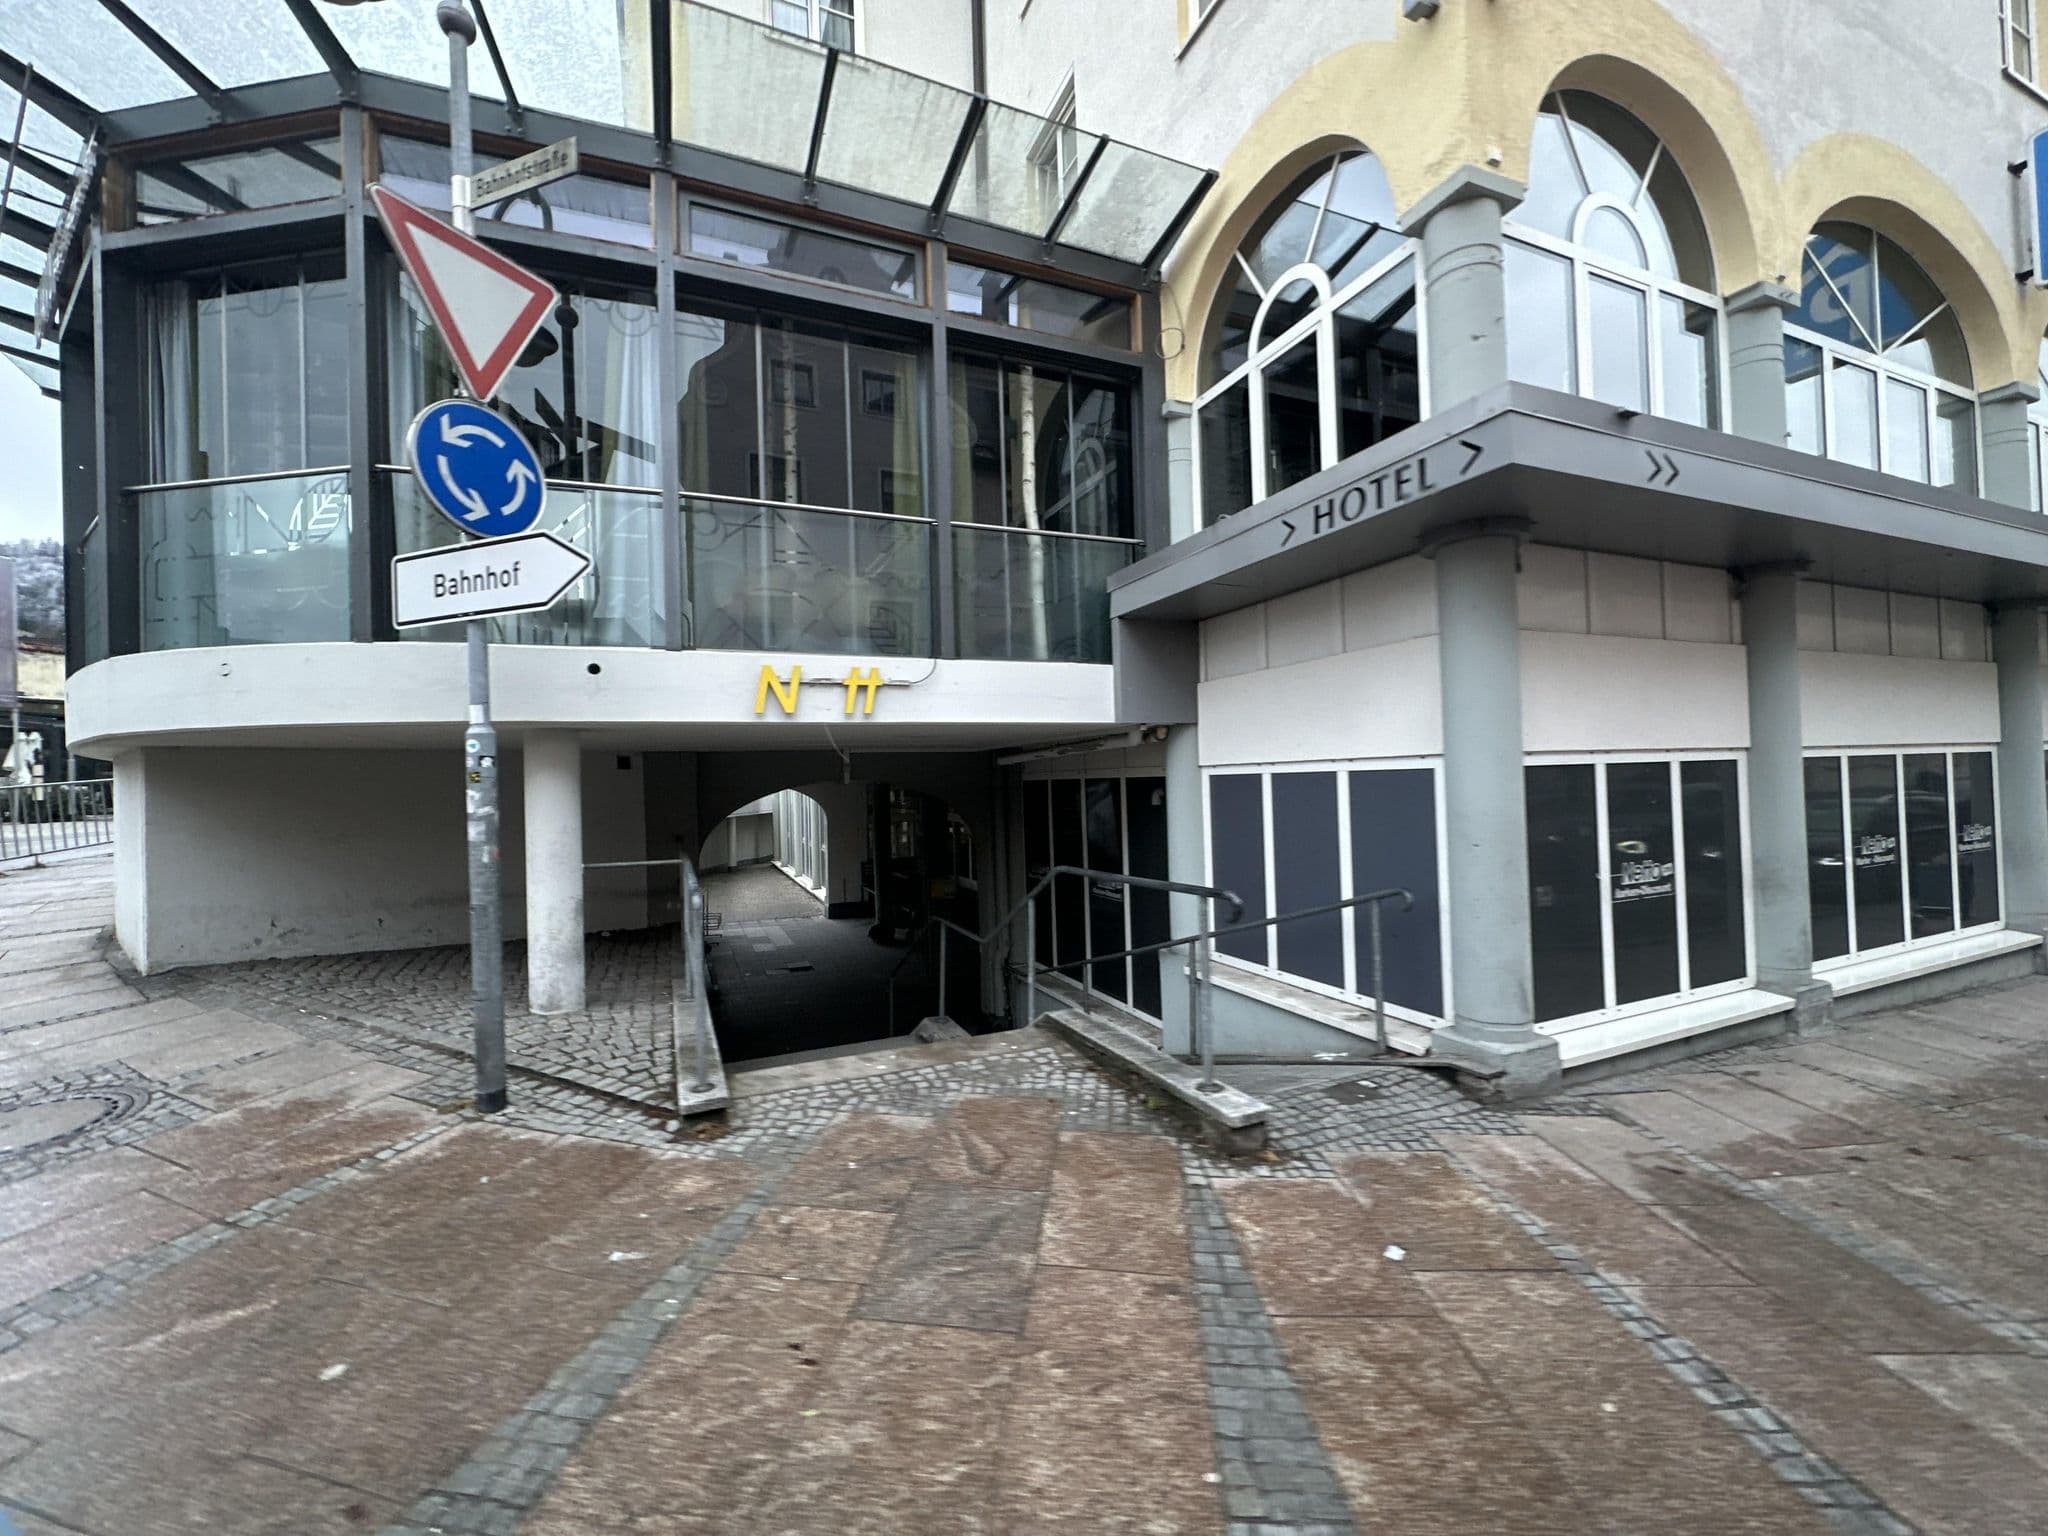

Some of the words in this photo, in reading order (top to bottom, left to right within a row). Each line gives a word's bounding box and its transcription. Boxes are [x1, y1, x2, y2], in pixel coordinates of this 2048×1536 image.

[476, 149, 569, 198] Bahnhofstraße
[1313, 458, 1434, 534] HOTEL
[434, 561, 521, 598] Bahnhof
